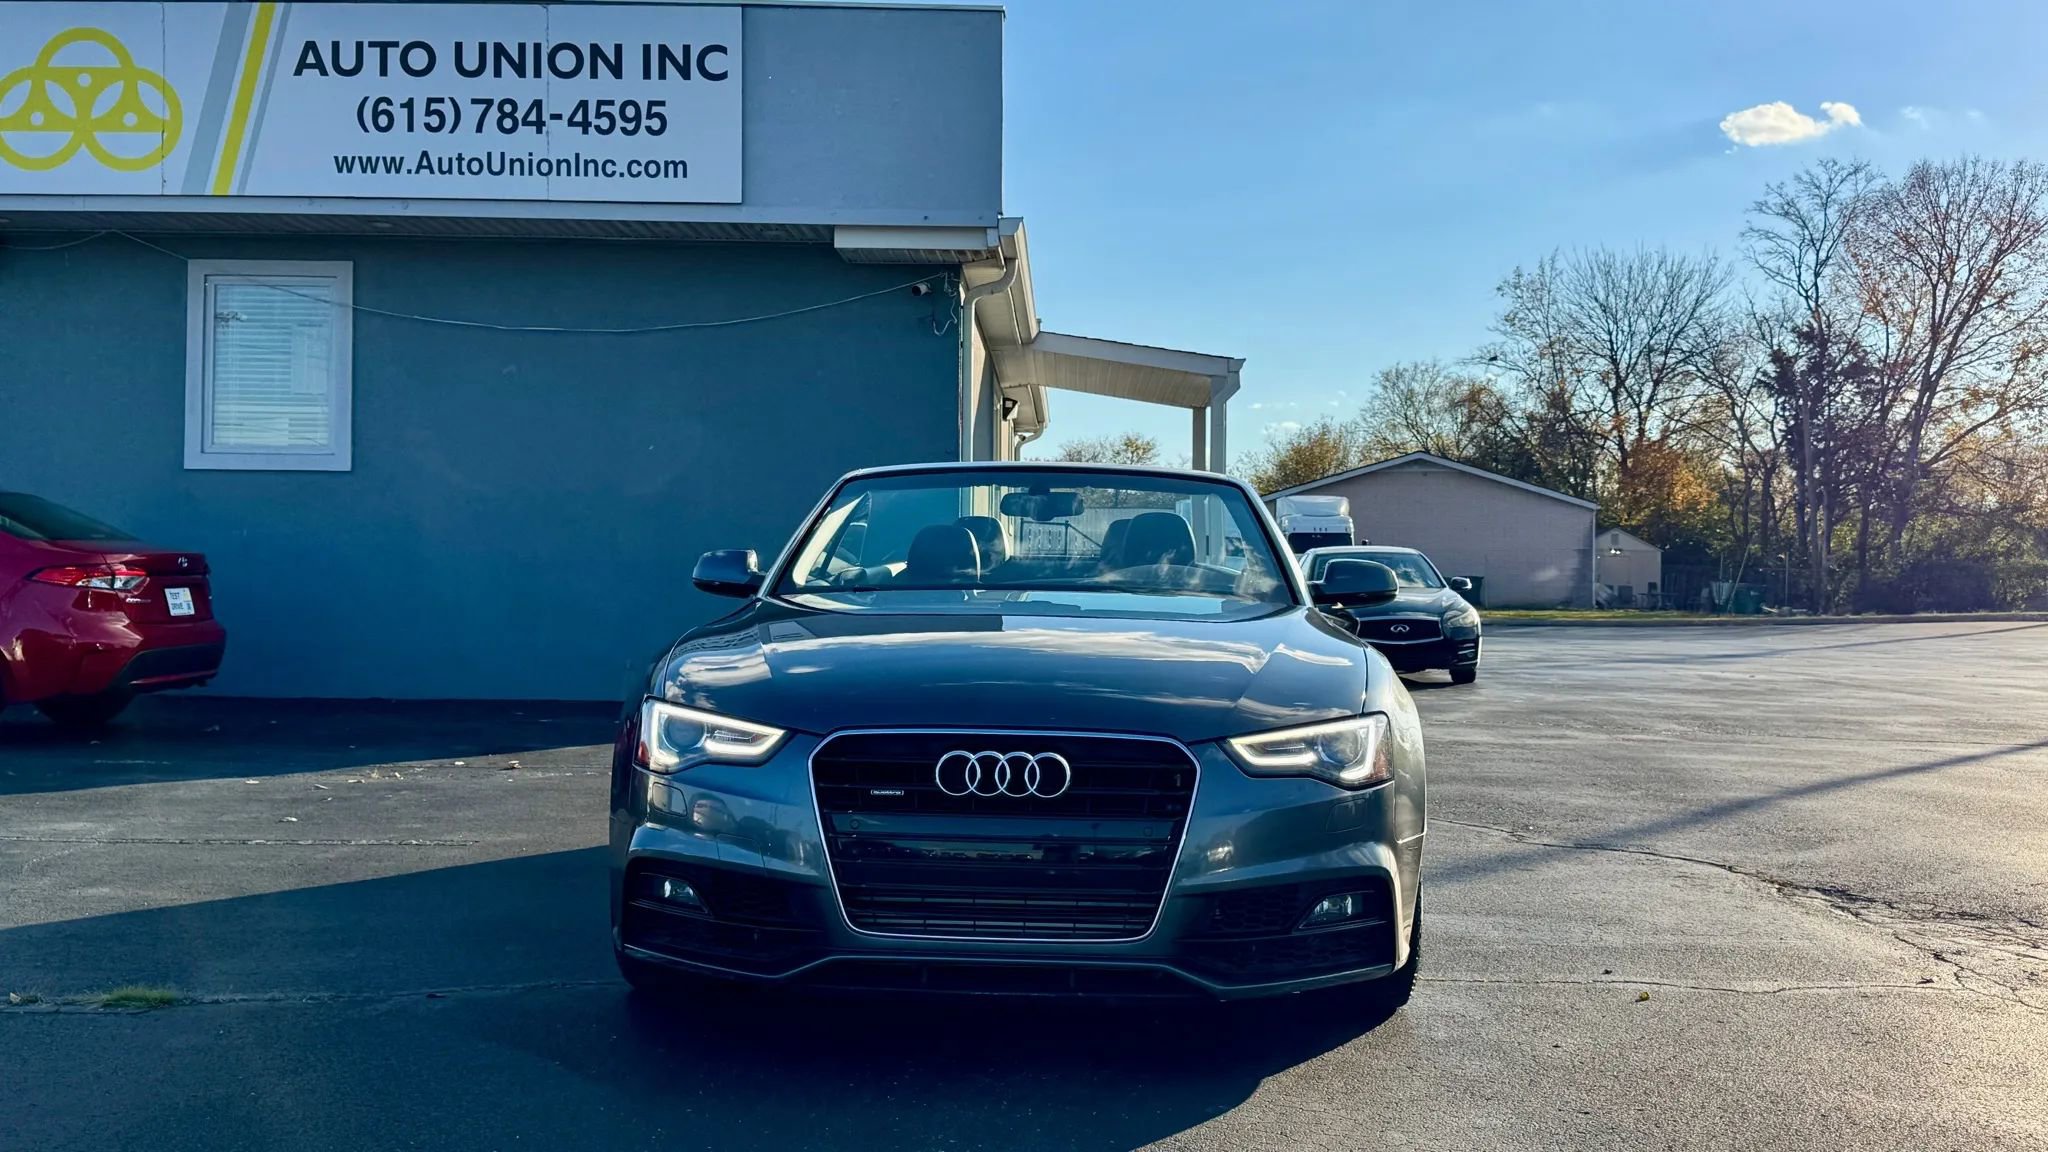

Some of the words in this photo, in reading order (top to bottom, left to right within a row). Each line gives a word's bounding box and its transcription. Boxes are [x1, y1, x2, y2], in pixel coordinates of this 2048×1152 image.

[293, 40, 437, 79] AUTO
[454, 41, 623, 80] UNION
[642, 43, 729, 82] INC
[356, 95, 462, 135] (615)
[470, 97, 668, 137] 784-4595
[333, 150, 688, 179] www.AutoUnionInc.com
